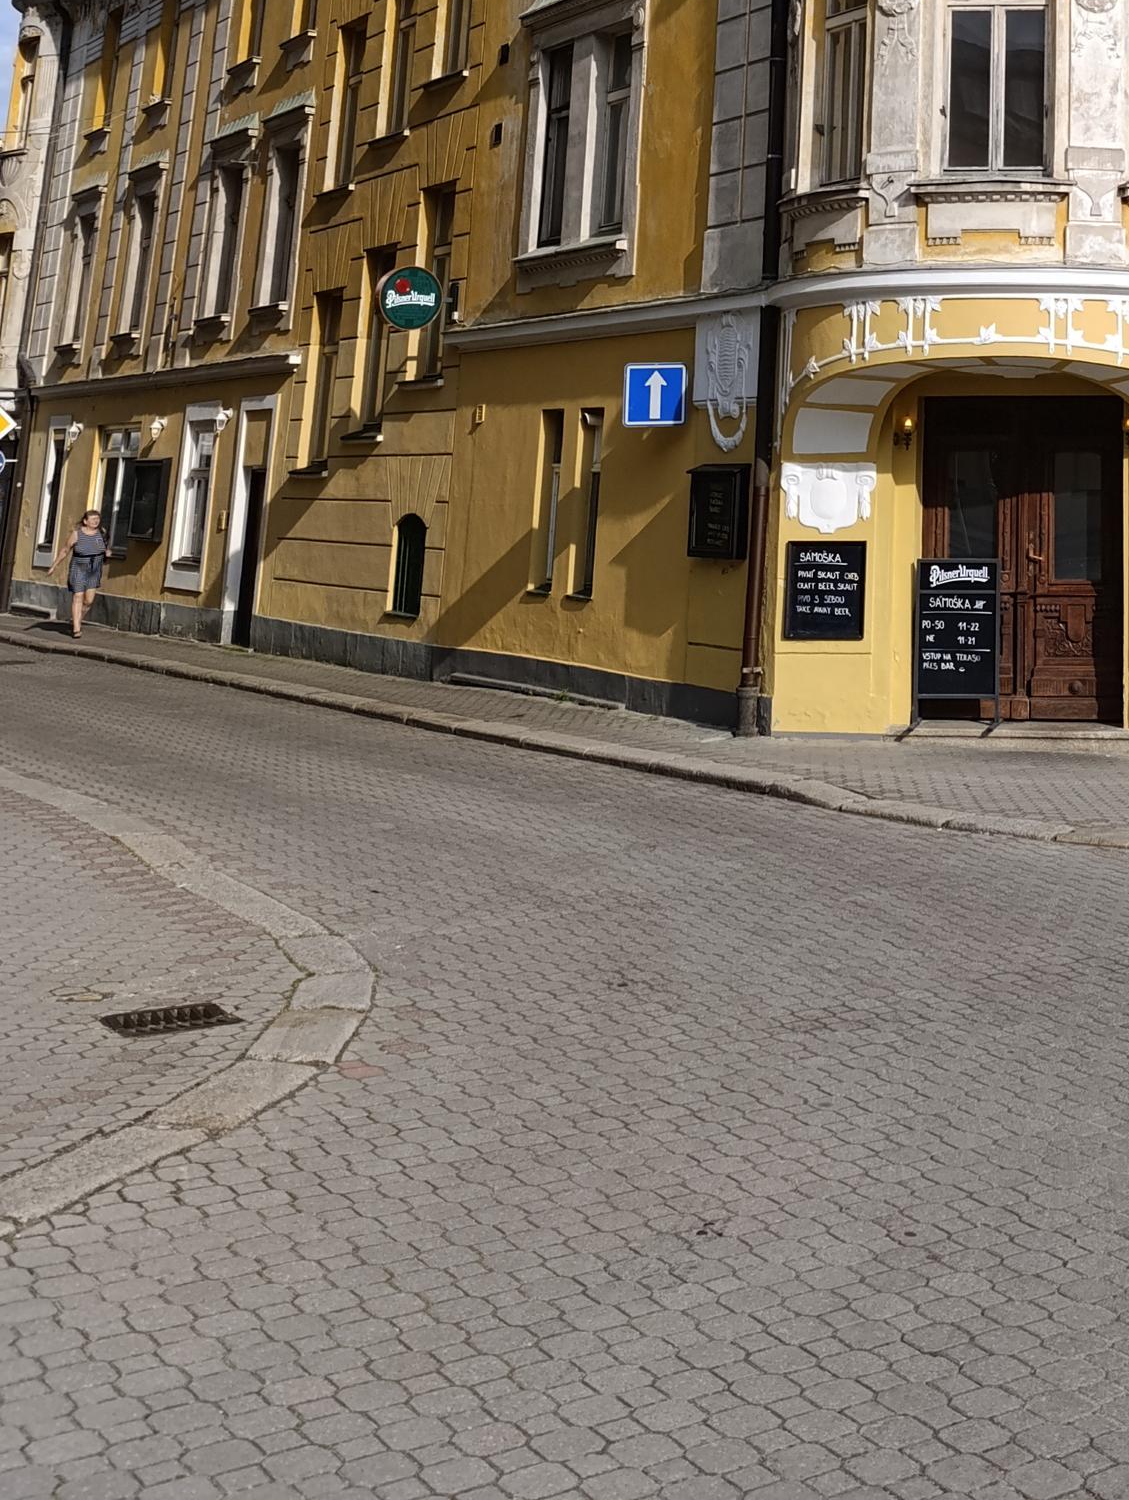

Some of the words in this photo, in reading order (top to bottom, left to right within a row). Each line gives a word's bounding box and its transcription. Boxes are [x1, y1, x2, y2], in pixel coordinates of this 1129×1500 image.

[386, 289, 411, 308] Pilsner
[411, 290, 436, 306] Urquell
[799, 549, 842, 563] SÁMOŠKA
[817, 571, 840, 580] SKAUT
[929, 565, 960, 588] Pilsner
[959, 564, 989, 583] Urquell
[818, 582, 836, 590] BEER
[837, 582, 858, 591] SKAUT
[813, 594, 820, 604] S
[823, 594, 845, 604] SEBOU
[929, 595, 971, 610] SÁMOŠKA
[796, 605, 811, 613] TAKE
[813, 606, 831, 614] AWAY
[957, 621, 980, 631] 11-22
[926, 634, 936, 642] NE
[957, 636, 976, 645] 11-21
[922, 652, 941, 661] VSTUP
[943, 653, 952, 661] NA
[941, 661, 956, 671] BAR
